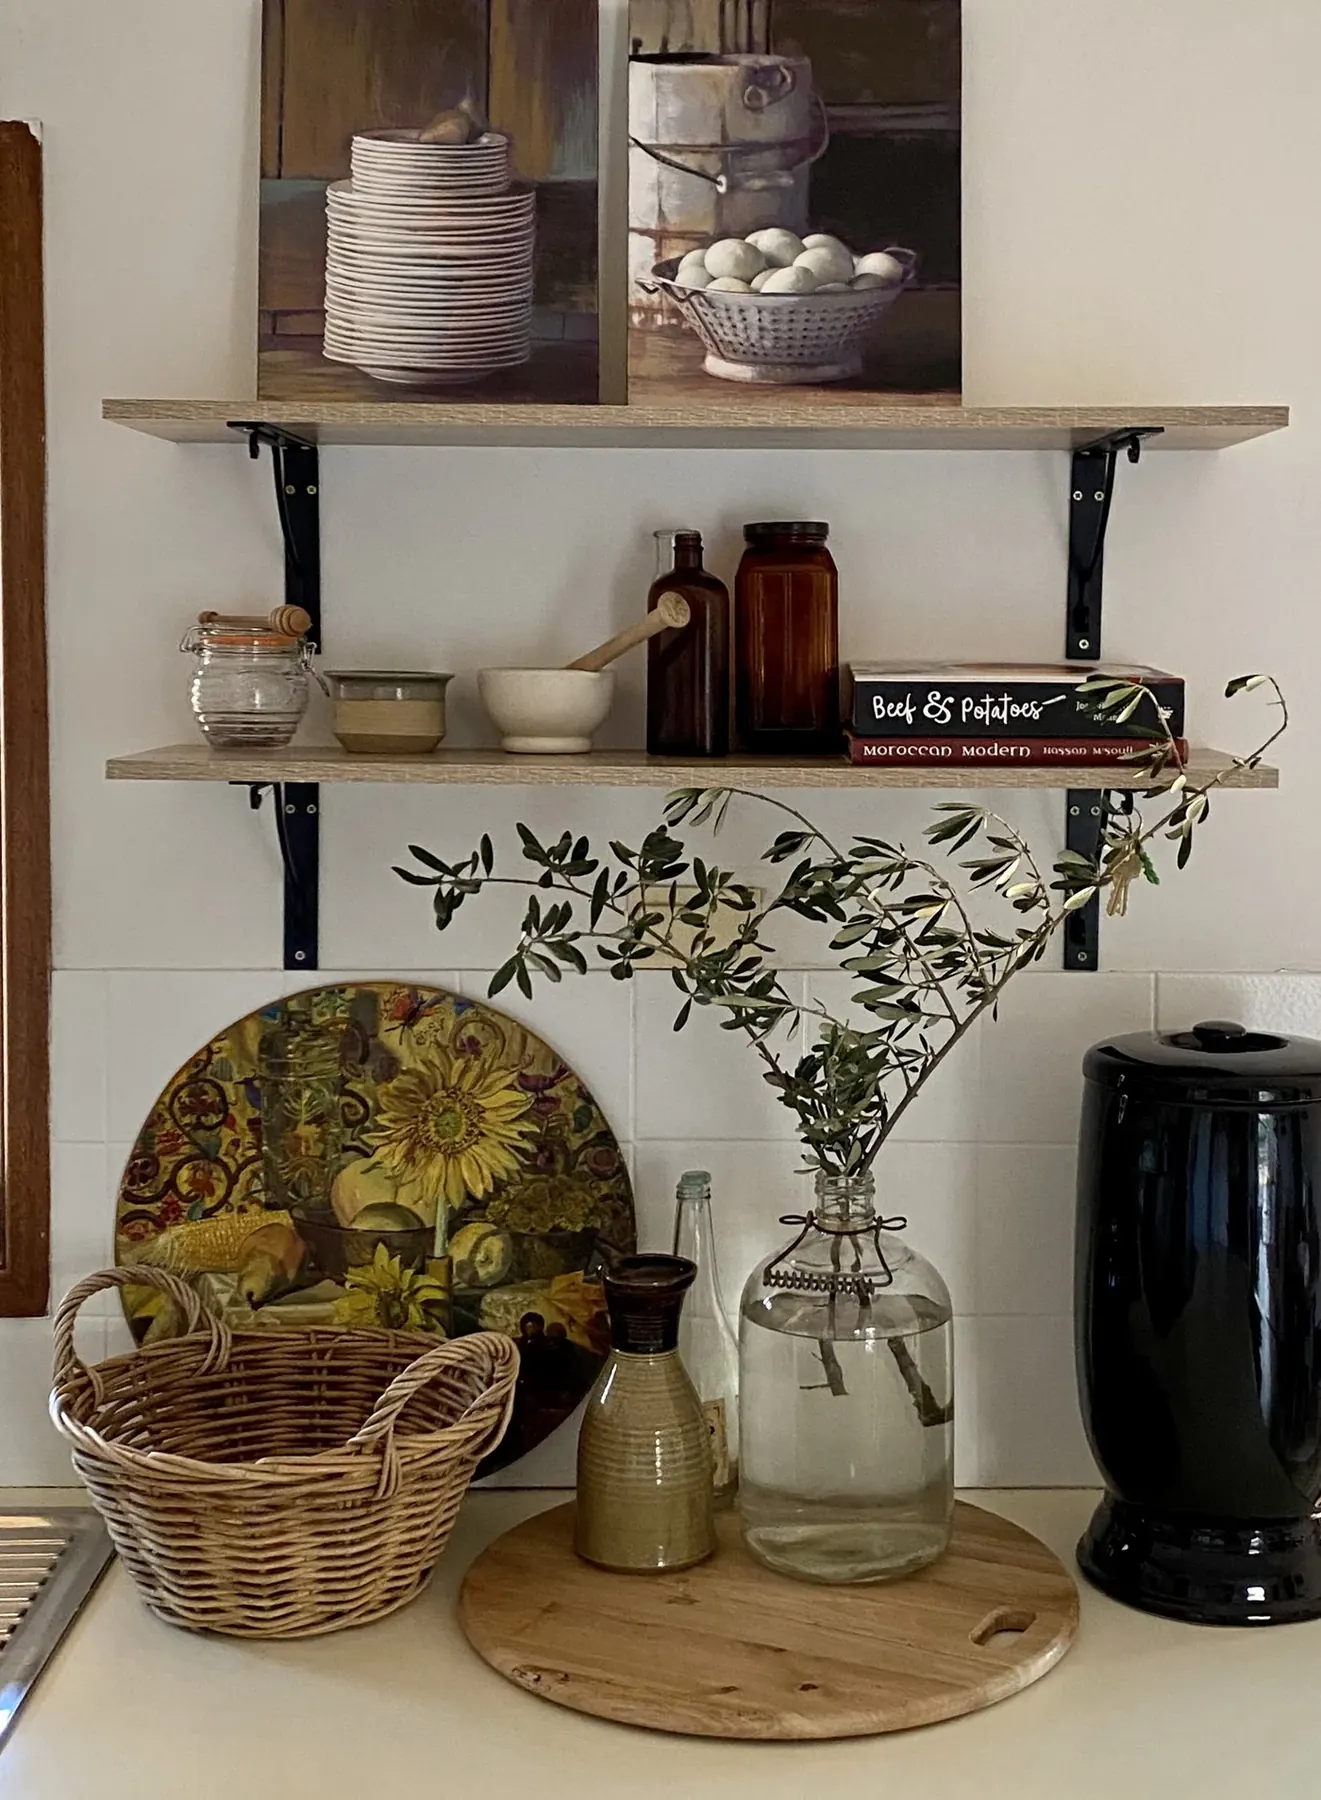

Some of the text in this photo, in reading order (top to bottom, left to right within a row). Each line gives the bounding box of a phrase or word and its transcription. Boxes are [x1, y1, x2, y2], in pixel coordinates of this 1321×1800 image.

[872, 692, 917, 725] Beef
[923, 691, 955, 725] &
[961, 692, 1067, 725] Potatoes
[863, 743, 1031, 758] Moroccan Modern
